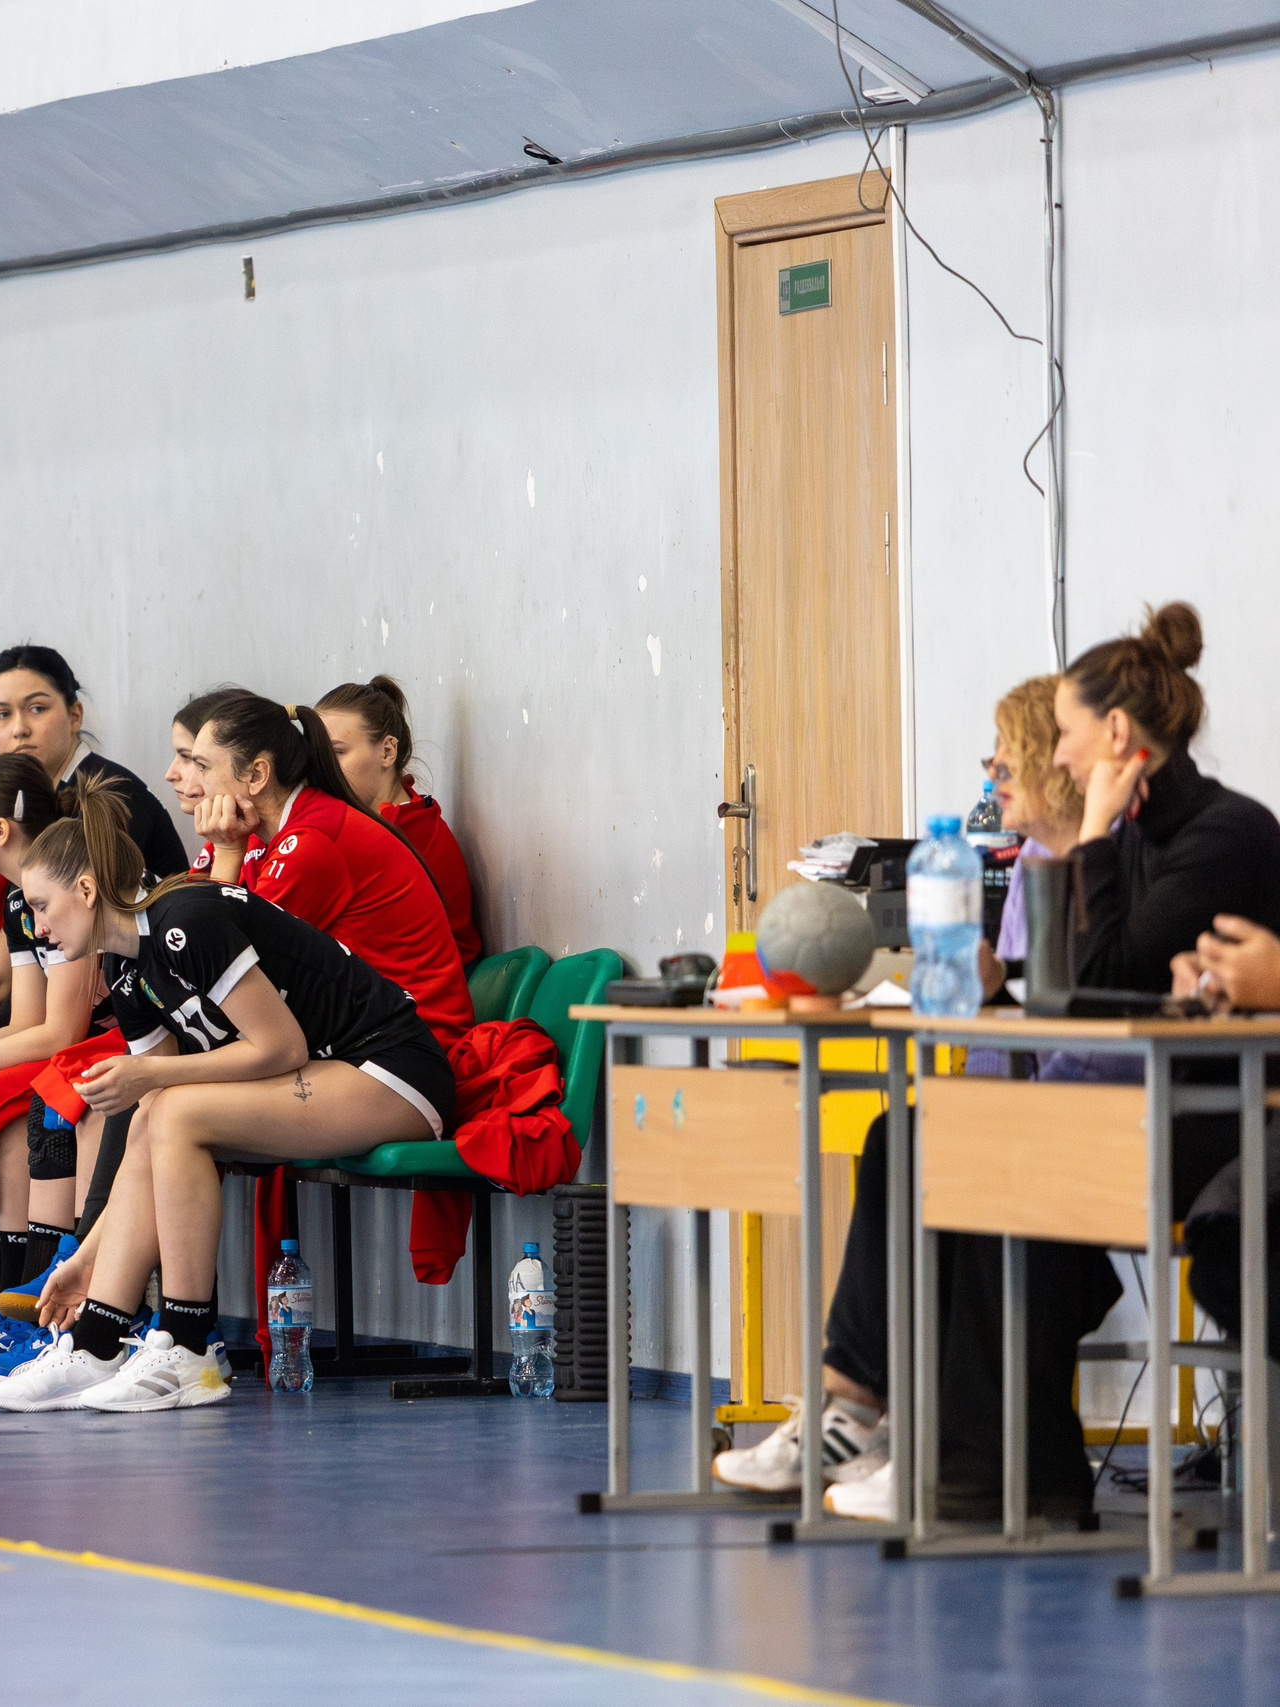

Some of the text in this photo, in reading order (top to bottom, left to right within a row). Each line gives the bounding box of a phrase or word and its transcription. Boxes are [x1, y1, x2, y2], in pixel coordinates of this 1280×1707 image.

[268, 860, 285, 879] 11
[28, 1223, 68, 1237] Kem
[7, 1234, 28, 1244] Ke
